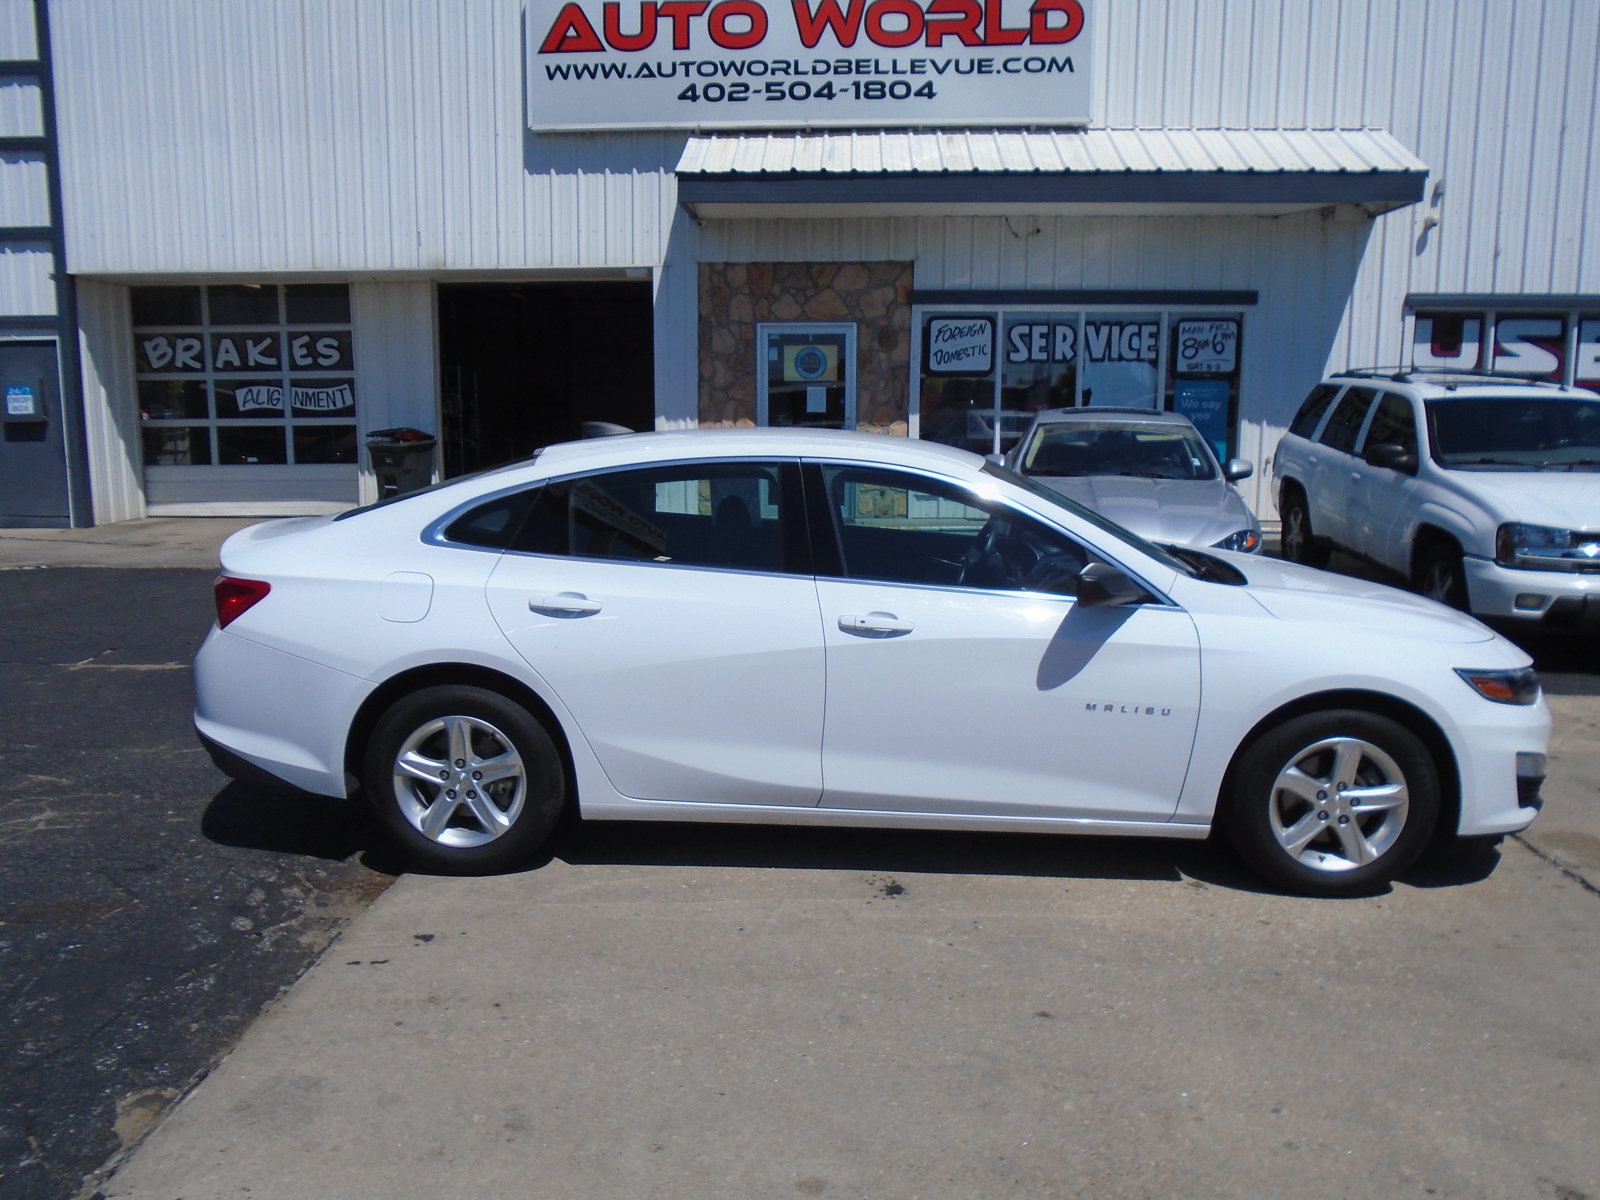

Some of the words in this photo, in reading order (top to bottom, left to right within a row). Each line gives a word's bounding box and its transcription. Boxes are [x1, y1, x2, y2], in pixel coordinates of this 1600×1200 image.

[537, 0, 769, 54] AUTO
[792, 0, 1084, 49] WORLD
[545, 56, 1075, 81] WWW.AUTOWORLDBELLEVUE.COM
[677, 80, 938, 102] 402-504-1804
[934, 322, 987, 343] FOREIGN
[1181, 325, 1205, 336] MON
[143, 334, 341, 370] BRAKES
[1009, 323, 1159, 363] SERVICE
[933, 344, 988, 366] DOMESTIC
[242, 387, 348, 408] ALIGNMENT
[1181, 399, 1199, 409] We
[1202, 400, 1221, 412] say
[1190, 411, 1210, 422] yes
[1085, 703, 1171, 717] MALIBU
